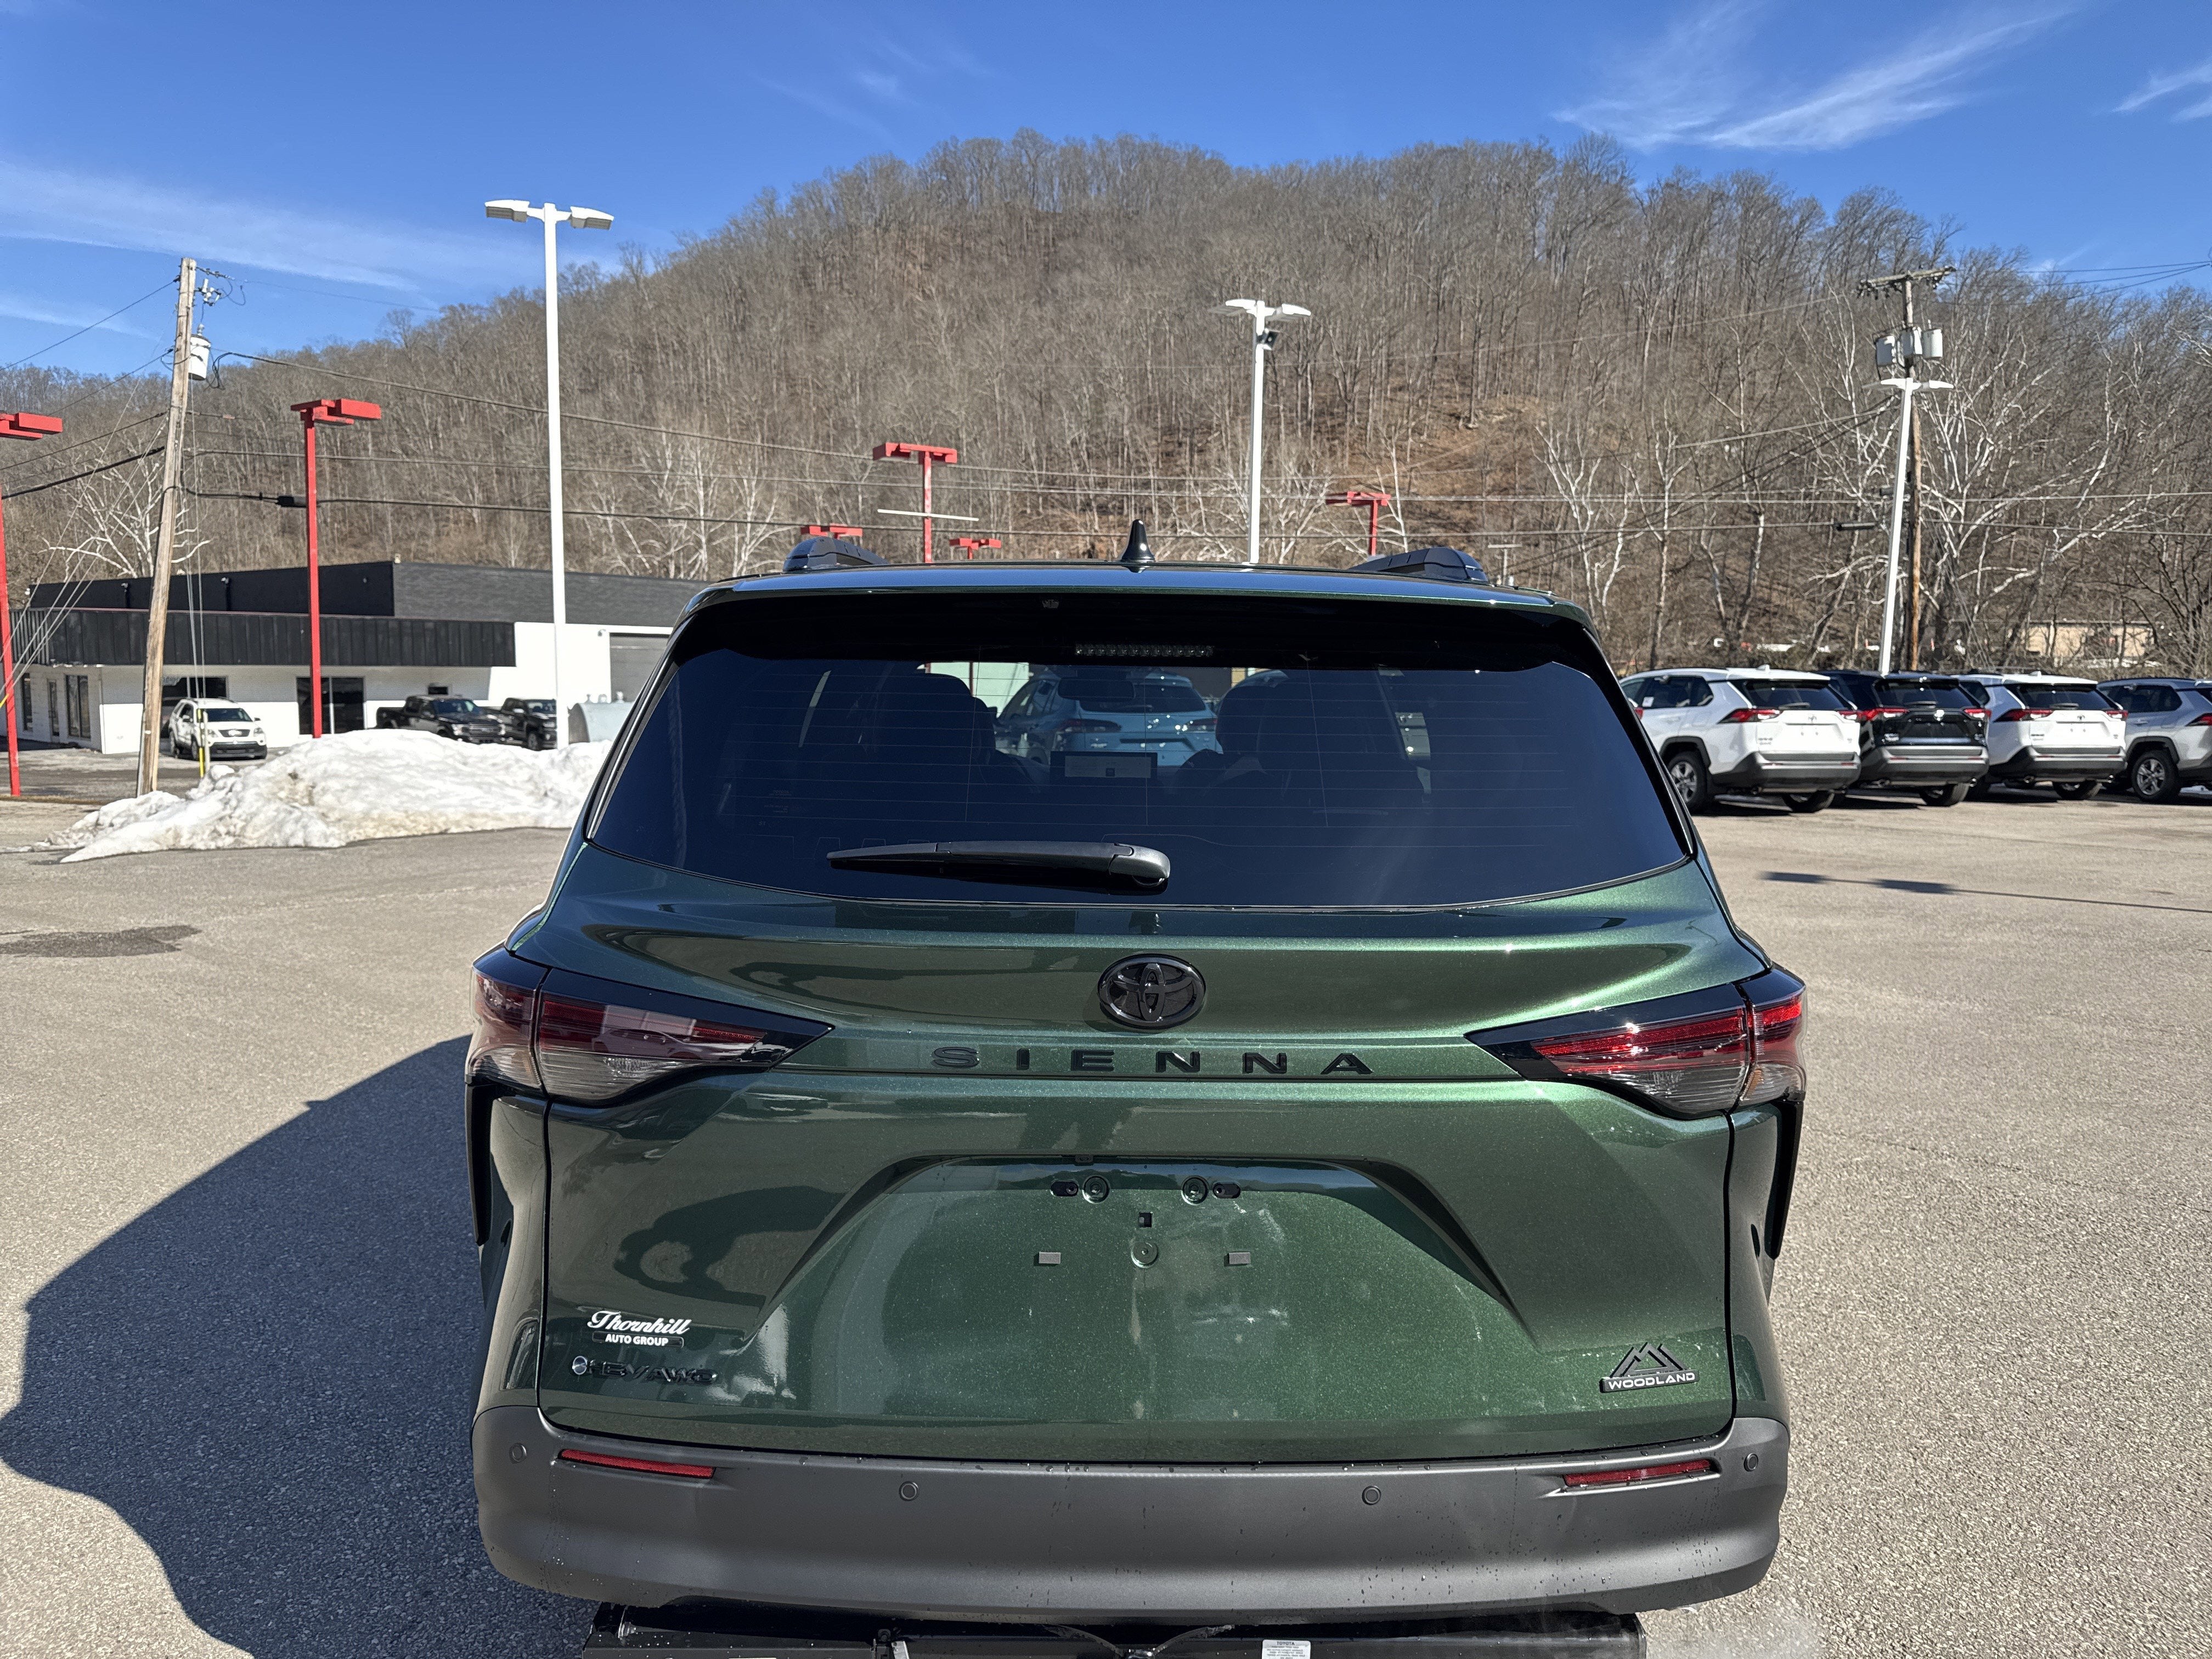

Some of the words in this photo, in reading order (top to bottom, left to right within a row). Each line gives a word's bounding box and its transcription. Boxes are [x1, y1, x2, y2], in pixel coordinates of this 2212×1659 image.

[932, 1046, 1373, 1074] SIENNA
[587, 1311, 692, 1334] Thornhill
[605, 1334, 631, 1344] AUTO
[633, 1335, 669, 1346] GROUP
[1608, 1372, 1695, 1390] WOODLAND
